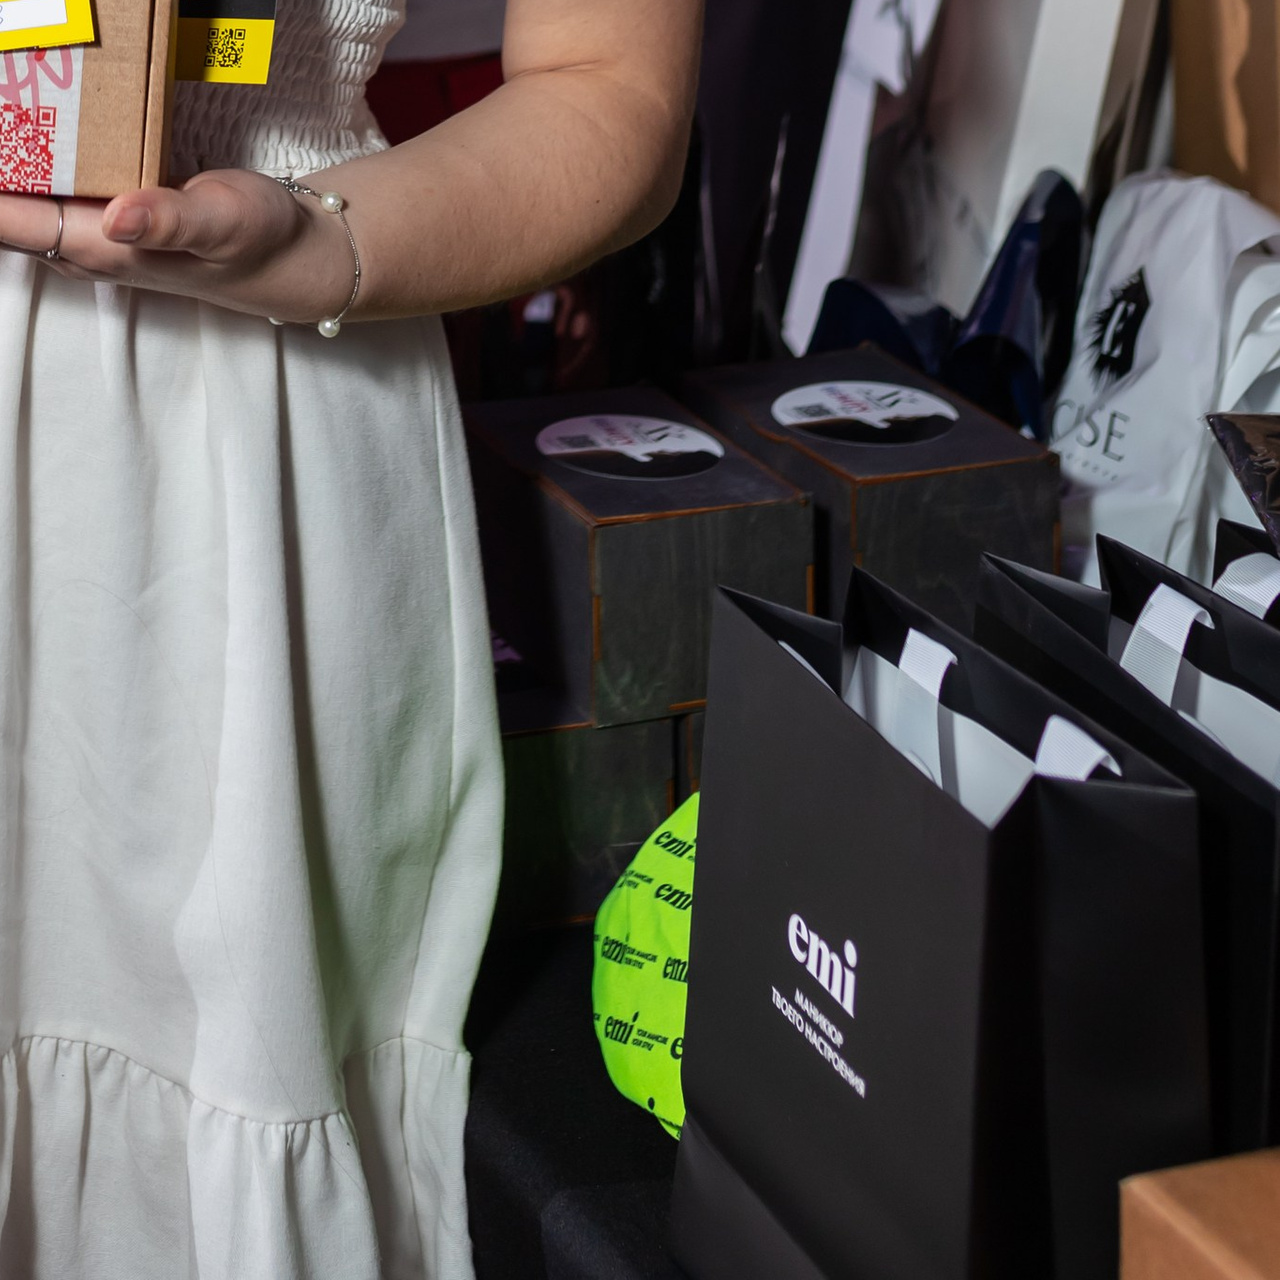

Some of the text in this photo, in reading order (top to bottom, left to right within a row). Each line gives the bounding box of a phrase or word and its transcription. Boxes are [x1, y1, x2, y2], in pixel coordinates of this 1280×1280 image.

[788, 913, 858, 1019] emi
[604, 1011, 640, 1045] emi
[771, 985, 805, 1033] ТВОЕГО
[794, 987, 844, 1049] МАНИКЮР
